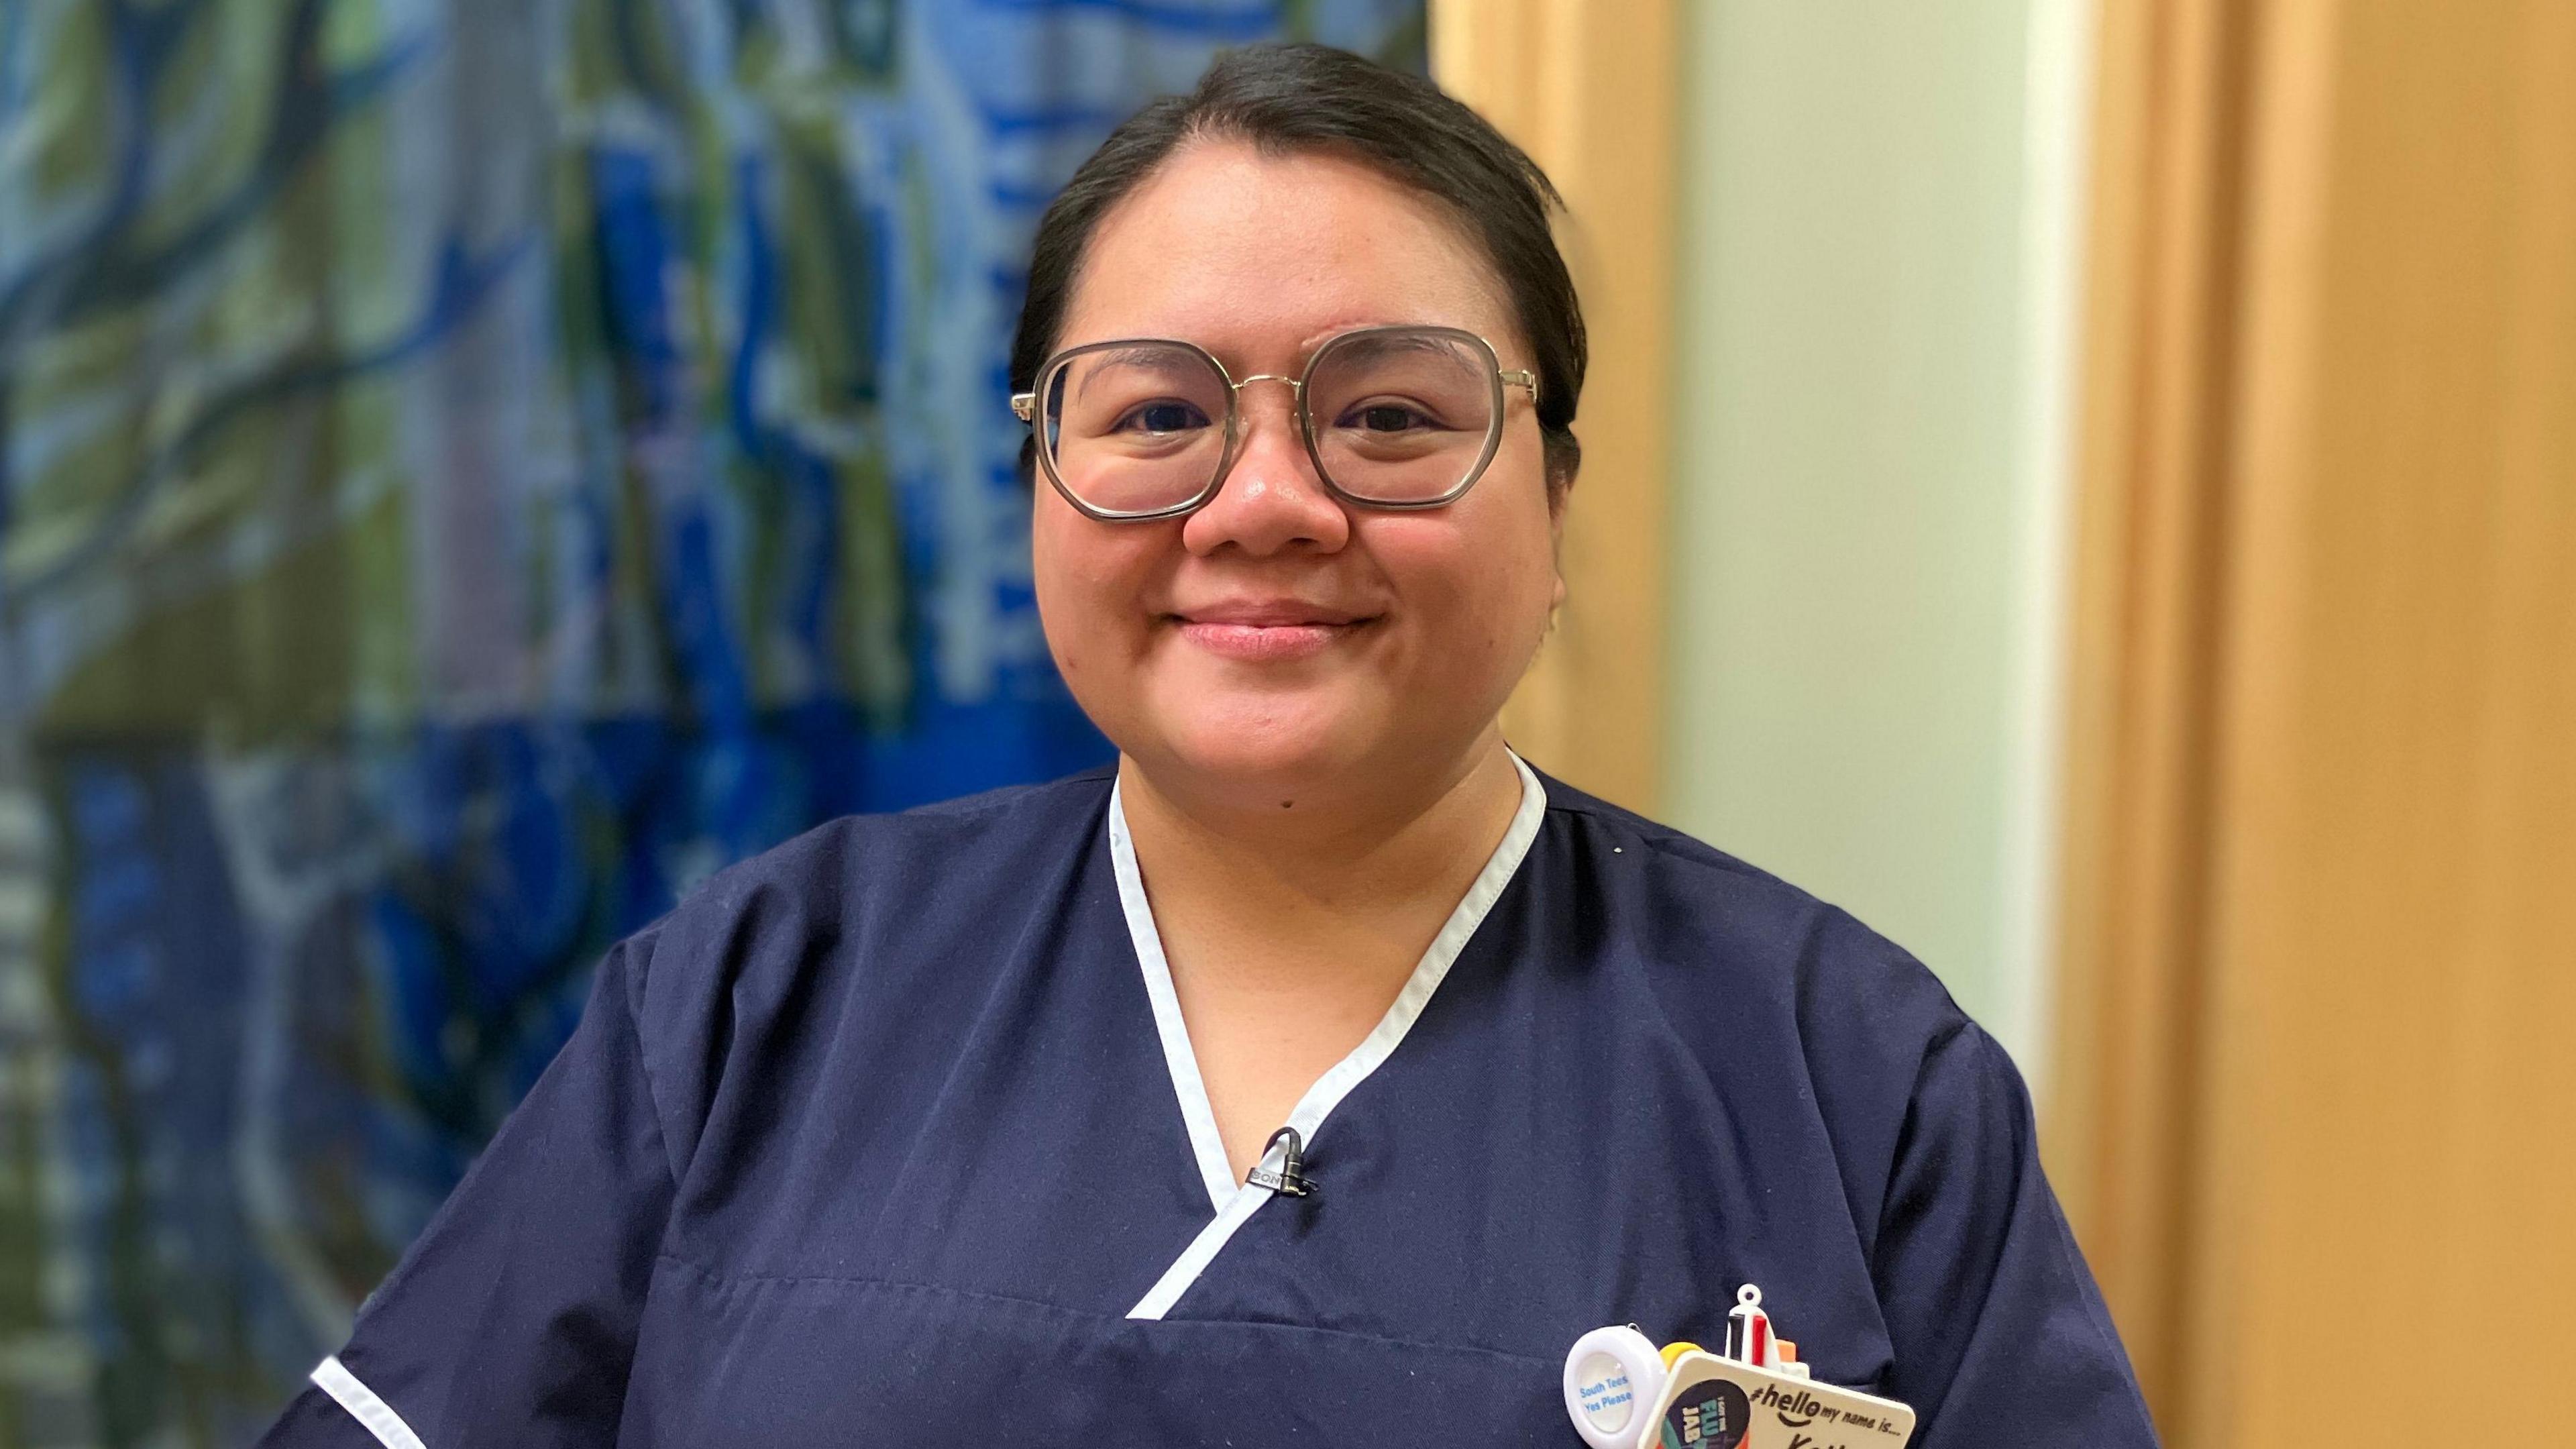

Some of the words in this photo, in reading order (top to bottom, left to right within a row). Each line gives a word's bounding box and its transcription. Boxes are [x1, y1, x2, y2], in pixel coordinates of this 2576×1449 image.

[1580, 1383, 1605, 1398] South
[1605, 1376, 1628, 1389] Tees
[1585, 1402, 1600, 1413] Yes
[1601, 1392, 1631, 1407] Please
[1700, 1399, 1719, 1436] FLU
[1750, 1383, 1821, 1417] #hello
[1820, 1407, 1840, 1424] my
[1841, 1412, 1875, 1428] name
[1682, 1407, 1701, 1443] JAB
